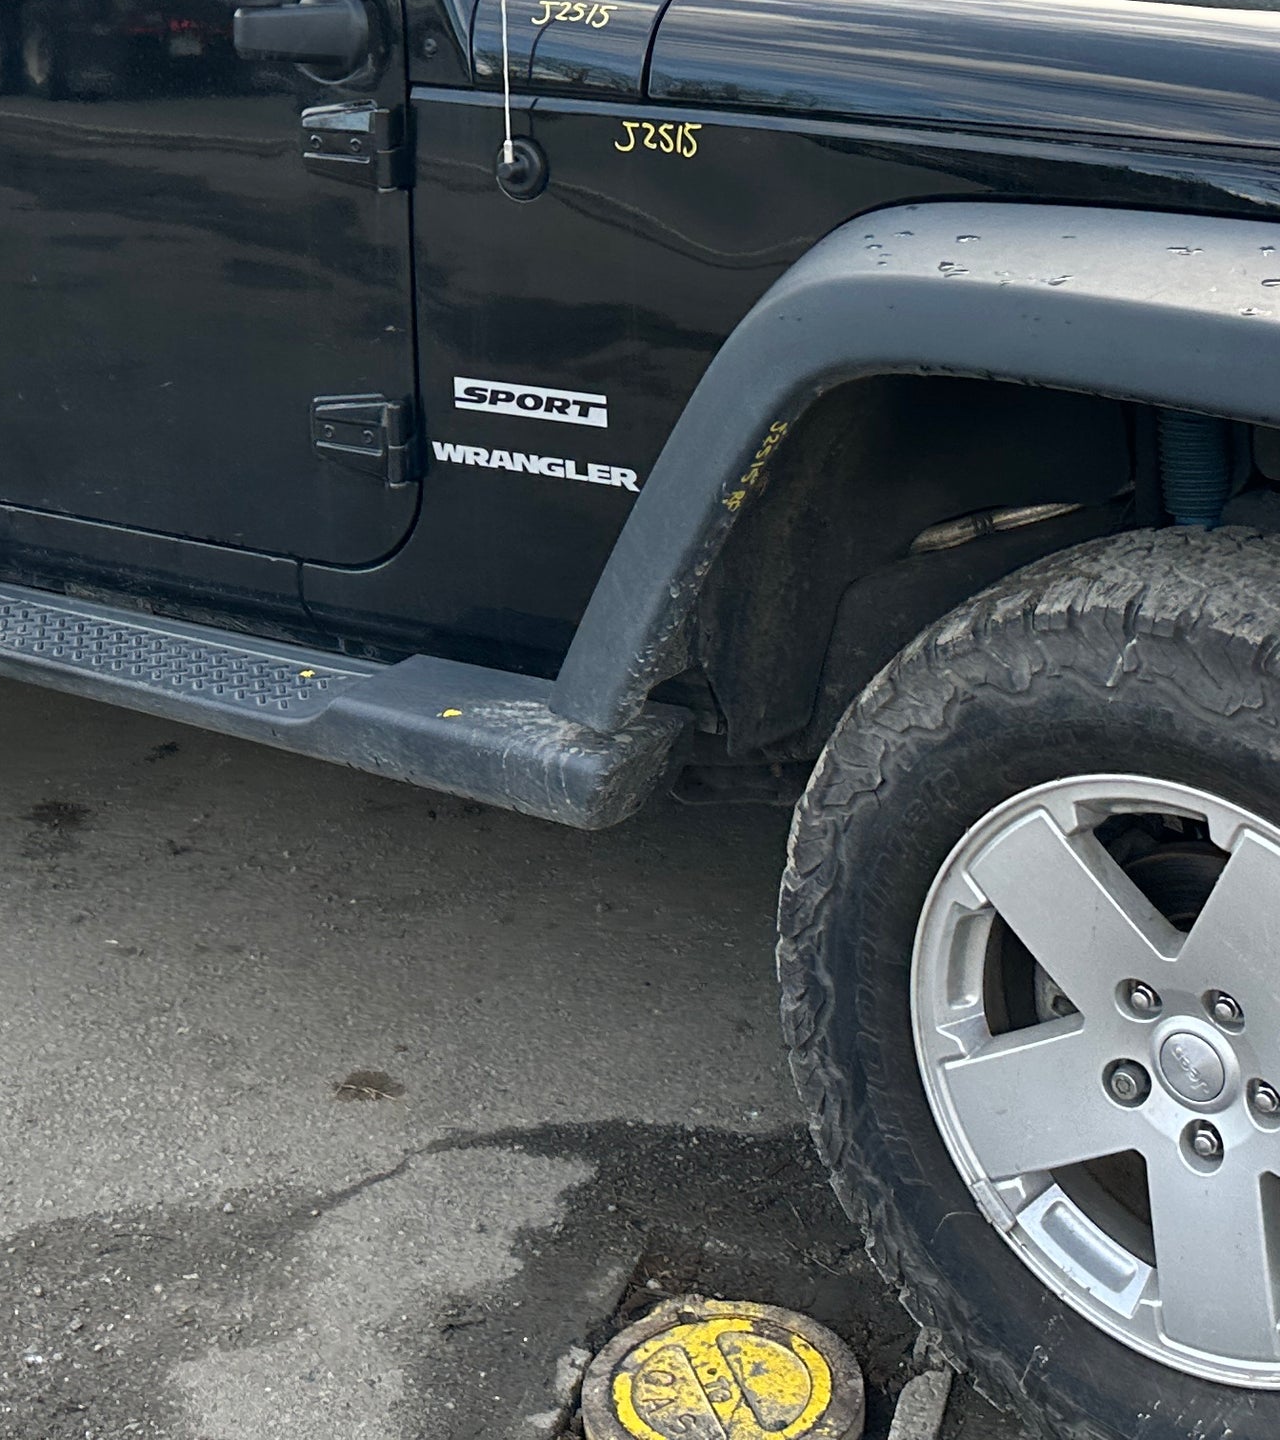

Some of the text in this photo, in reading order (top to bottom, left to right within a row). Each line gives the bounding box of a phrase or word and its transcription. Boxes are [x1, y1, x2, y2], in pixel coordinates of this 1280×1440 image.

[530, 0, 619, 29] J2515
[614, 120, 703, 159] J2515
[461, 386, 600, 419] SPORT
[431, 441, 640, 492] WRANGLER
